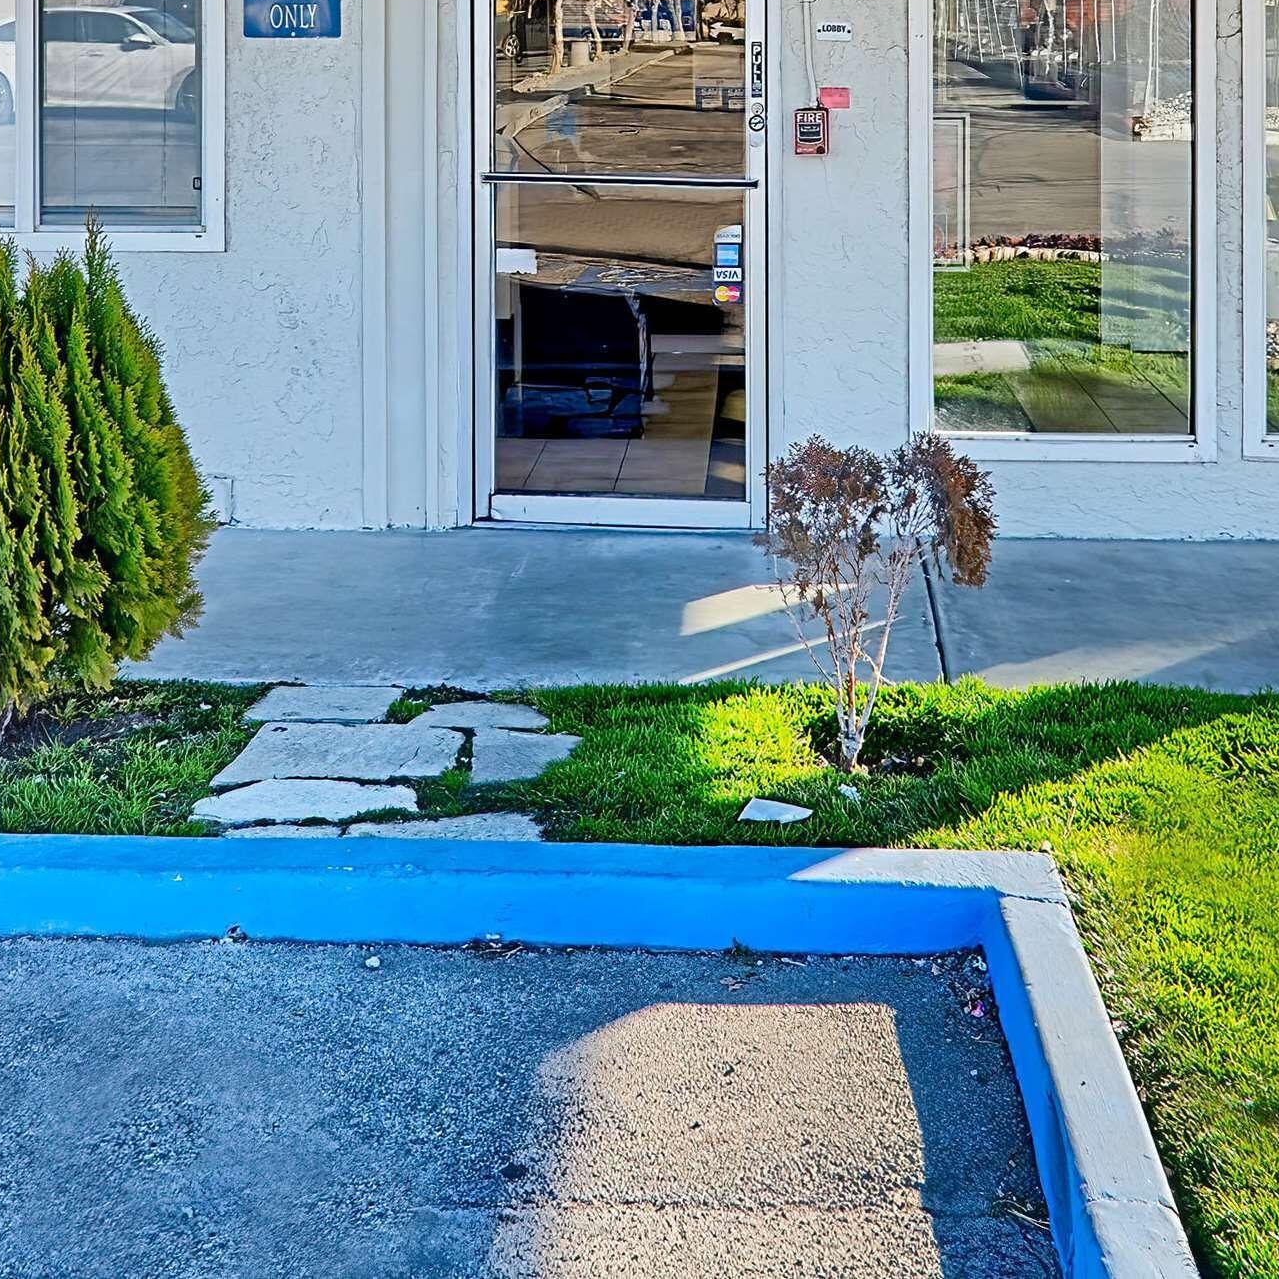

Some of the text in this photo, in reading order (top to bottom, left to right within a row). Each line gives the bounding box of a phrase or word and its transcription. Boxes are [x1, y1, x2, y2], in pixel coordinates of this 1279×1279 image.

[270, 4, 318, 29] ONLY
[822, 24, 847, 33] LOBBY
[752, 46, 762, 84] PULL
[797, 113, 823, 123] FIRE
[716, 270, 739, 280] VISA
